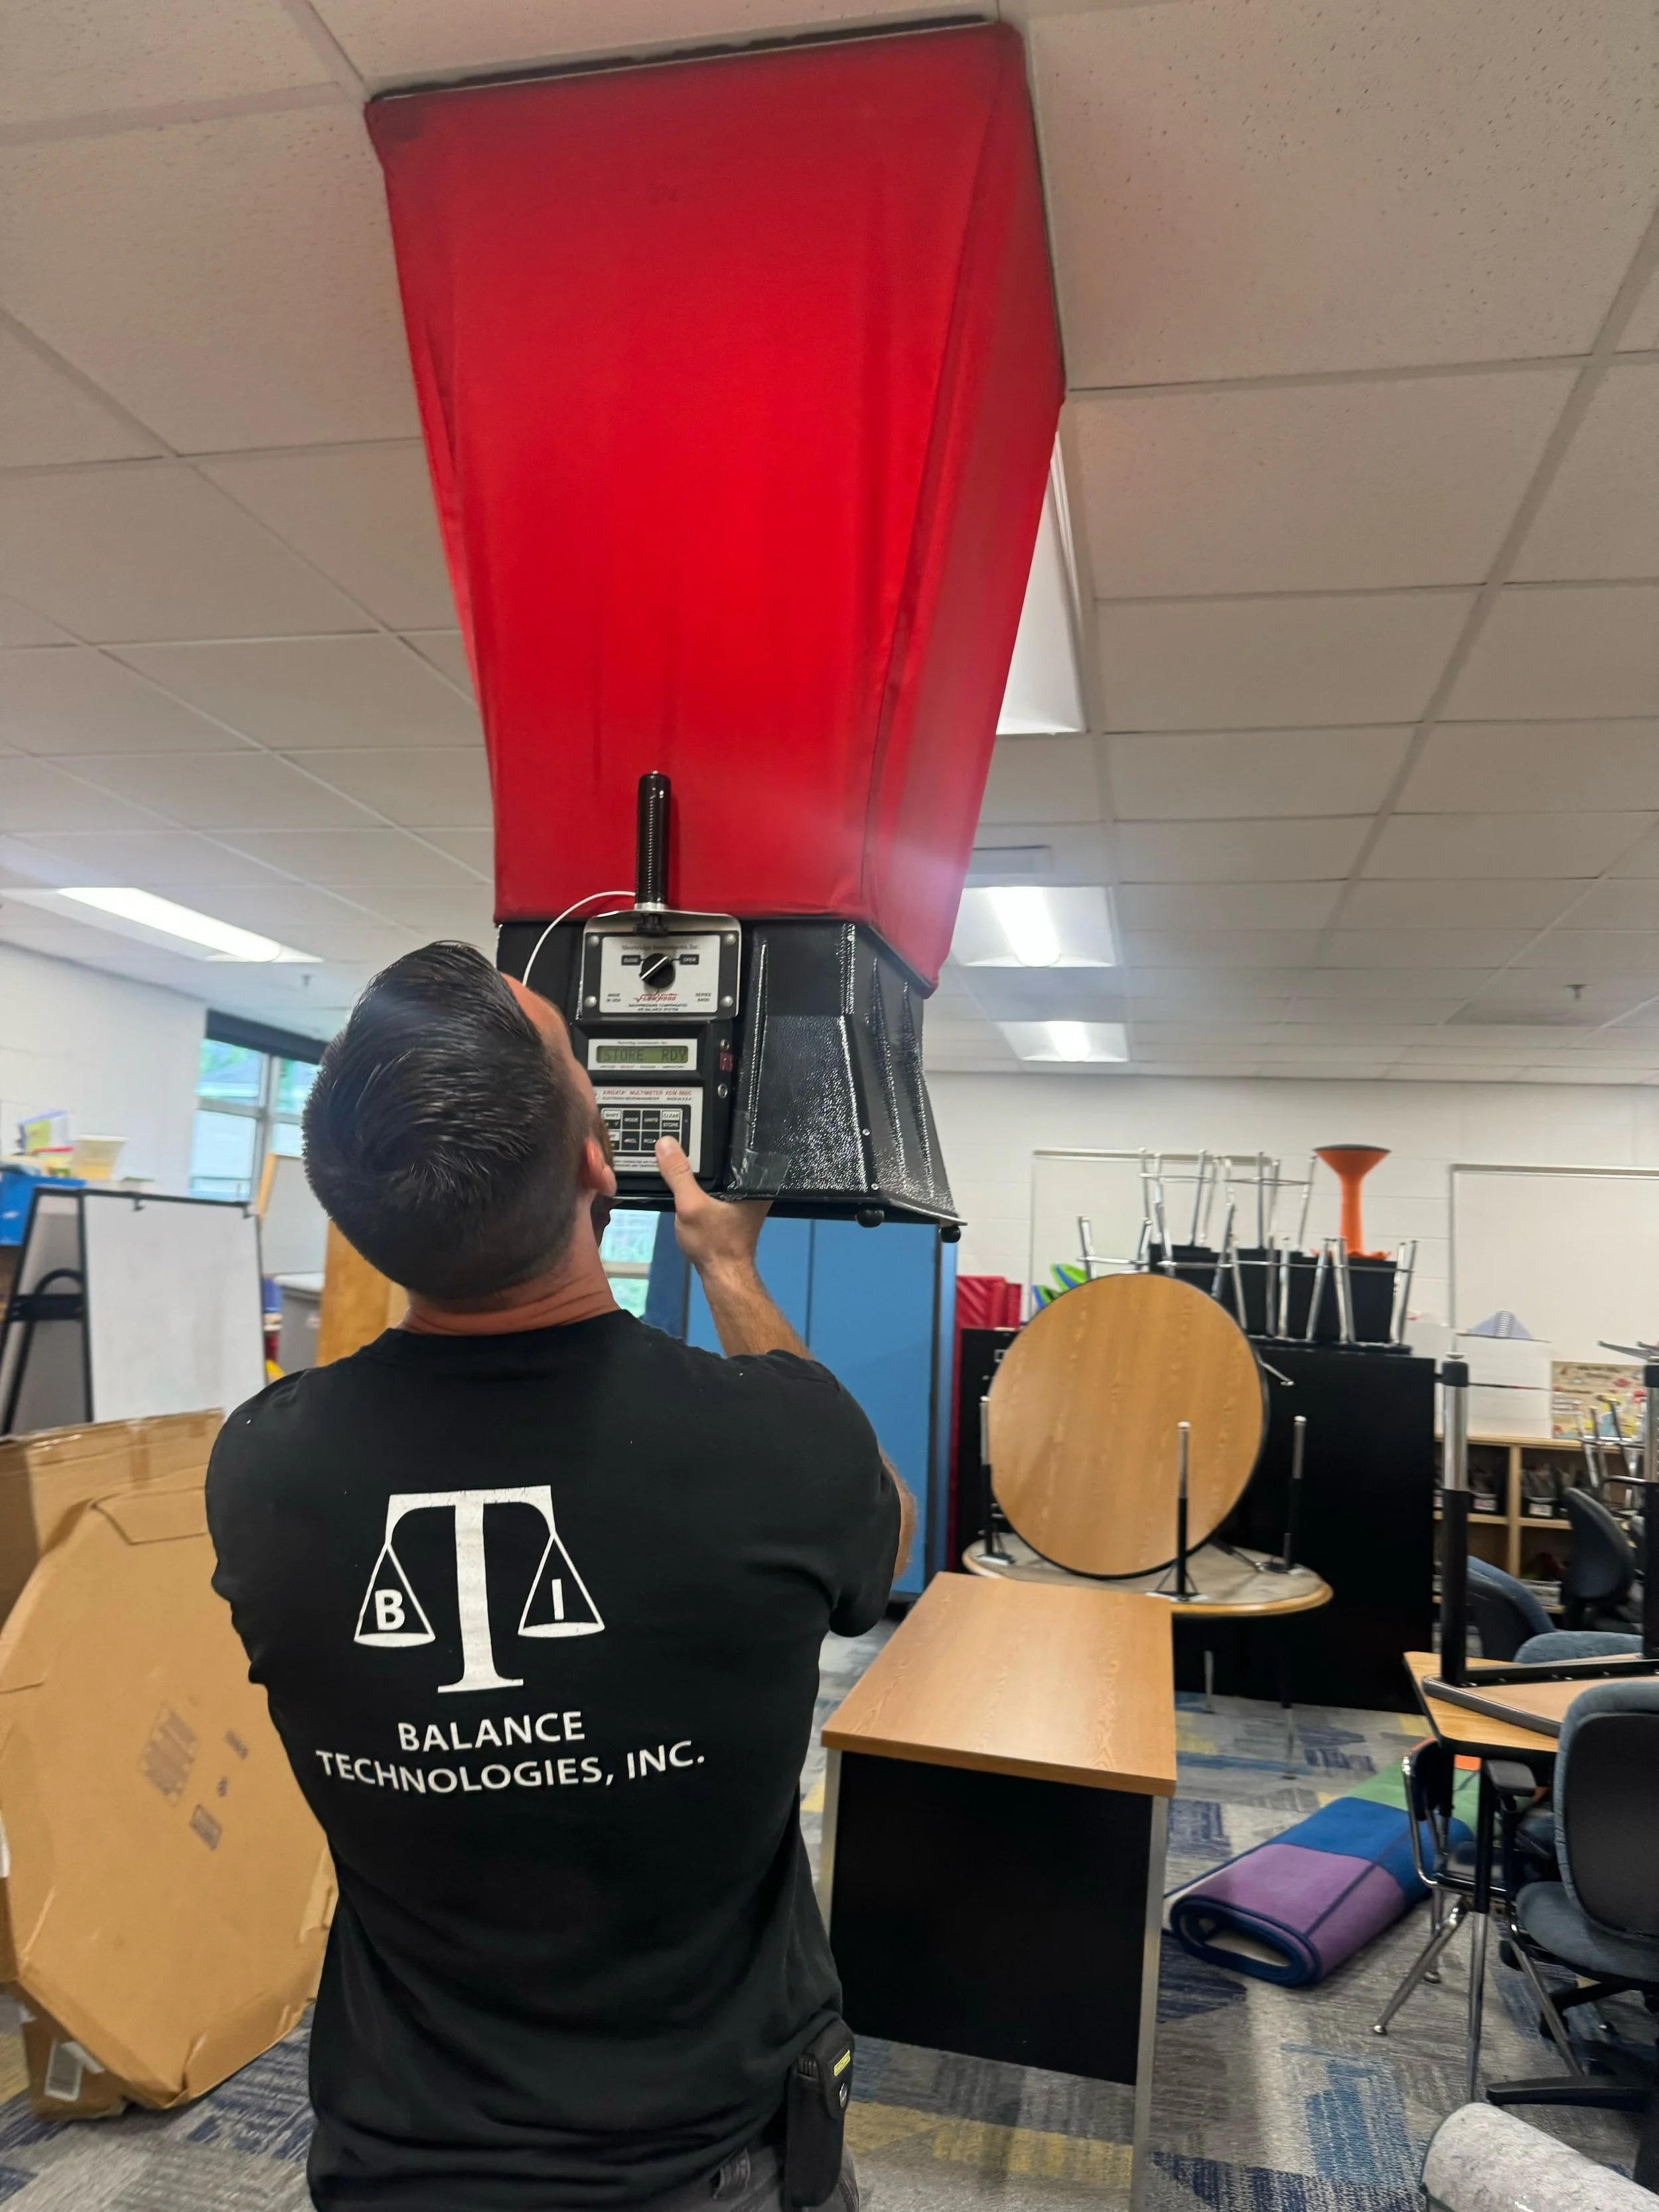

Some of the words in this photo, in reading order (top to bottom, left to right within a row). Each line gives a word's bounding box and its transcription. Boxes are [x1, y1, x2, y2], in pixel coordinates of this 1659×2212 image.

[603, 1049, 644, 1061] STORE
[661, 1048, 686, 1062] RDY
[374, 1588, 406, 1630] B
[398, 1711, 585, 1753] BALANCE
[315, 1750, 614, 1793] TECHNOLOGIES,
[626, 1740, 705, 1779] INC.
